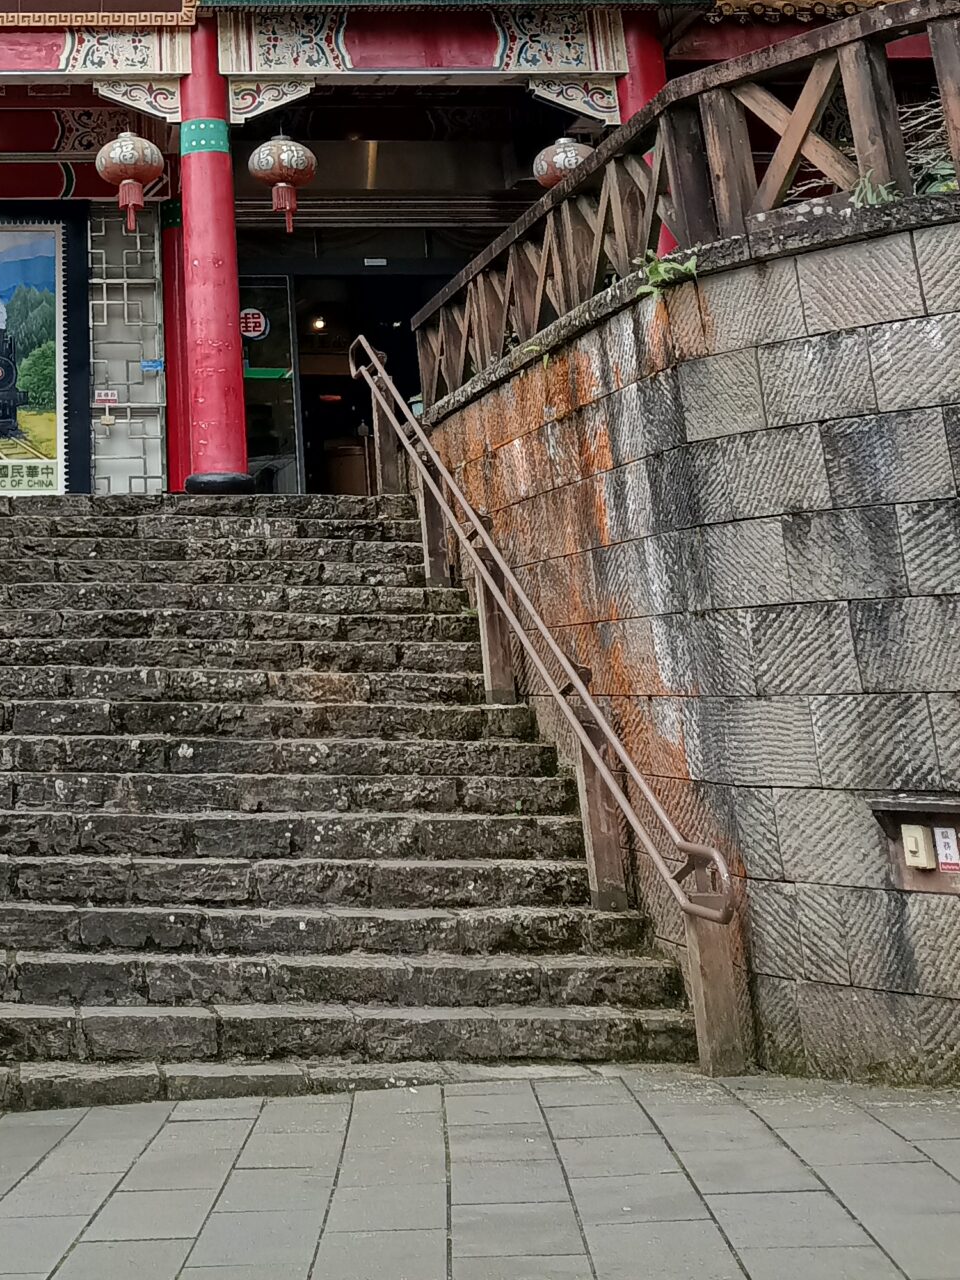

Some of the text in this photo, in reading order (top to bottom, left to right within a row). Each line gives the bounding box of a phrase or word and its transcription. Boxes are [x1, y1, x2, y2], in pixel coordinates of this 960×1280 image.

[240, 312, 261, 332] 郵
[10, 480, 23, 488] OF
[27, 480, 53, 488] CHINA
